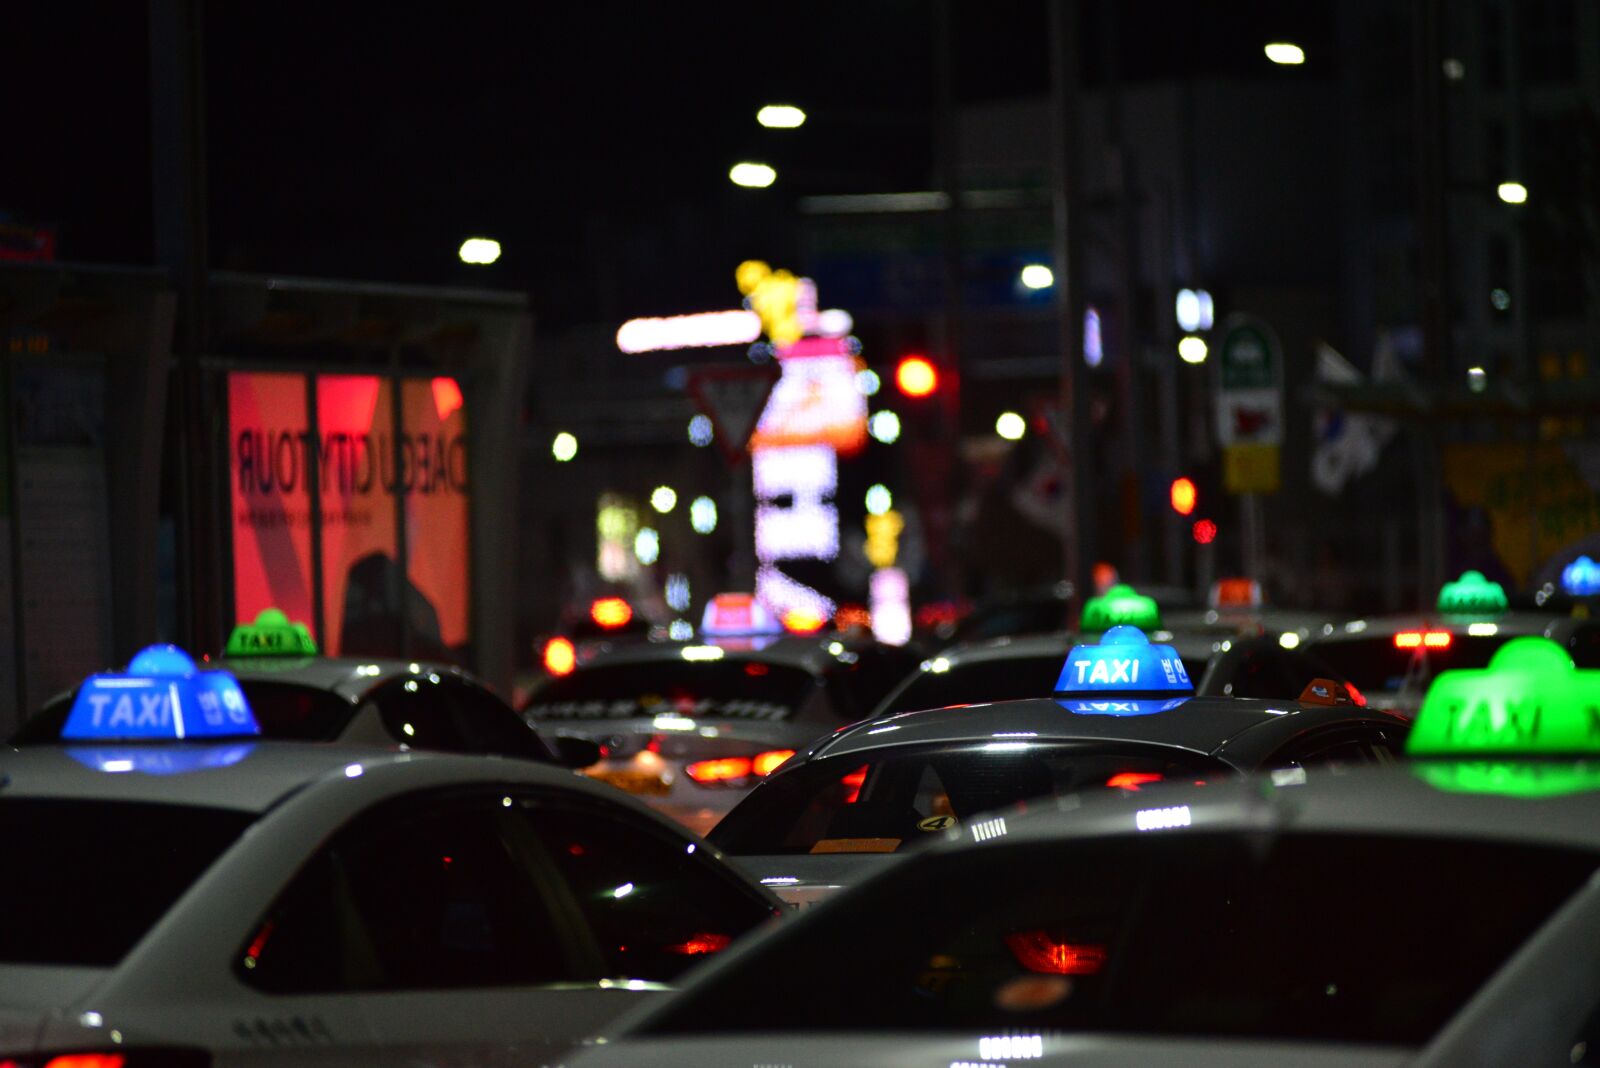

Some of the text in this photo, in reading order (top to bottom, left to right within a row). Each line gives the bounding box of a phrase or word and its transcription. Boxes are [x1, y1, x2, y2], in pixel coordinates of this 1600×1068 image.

[240, 633, 283, 650] TAXI
[1073, 658, 1140, 684] TAXI
[87, 692, 171, 728] TAXI
